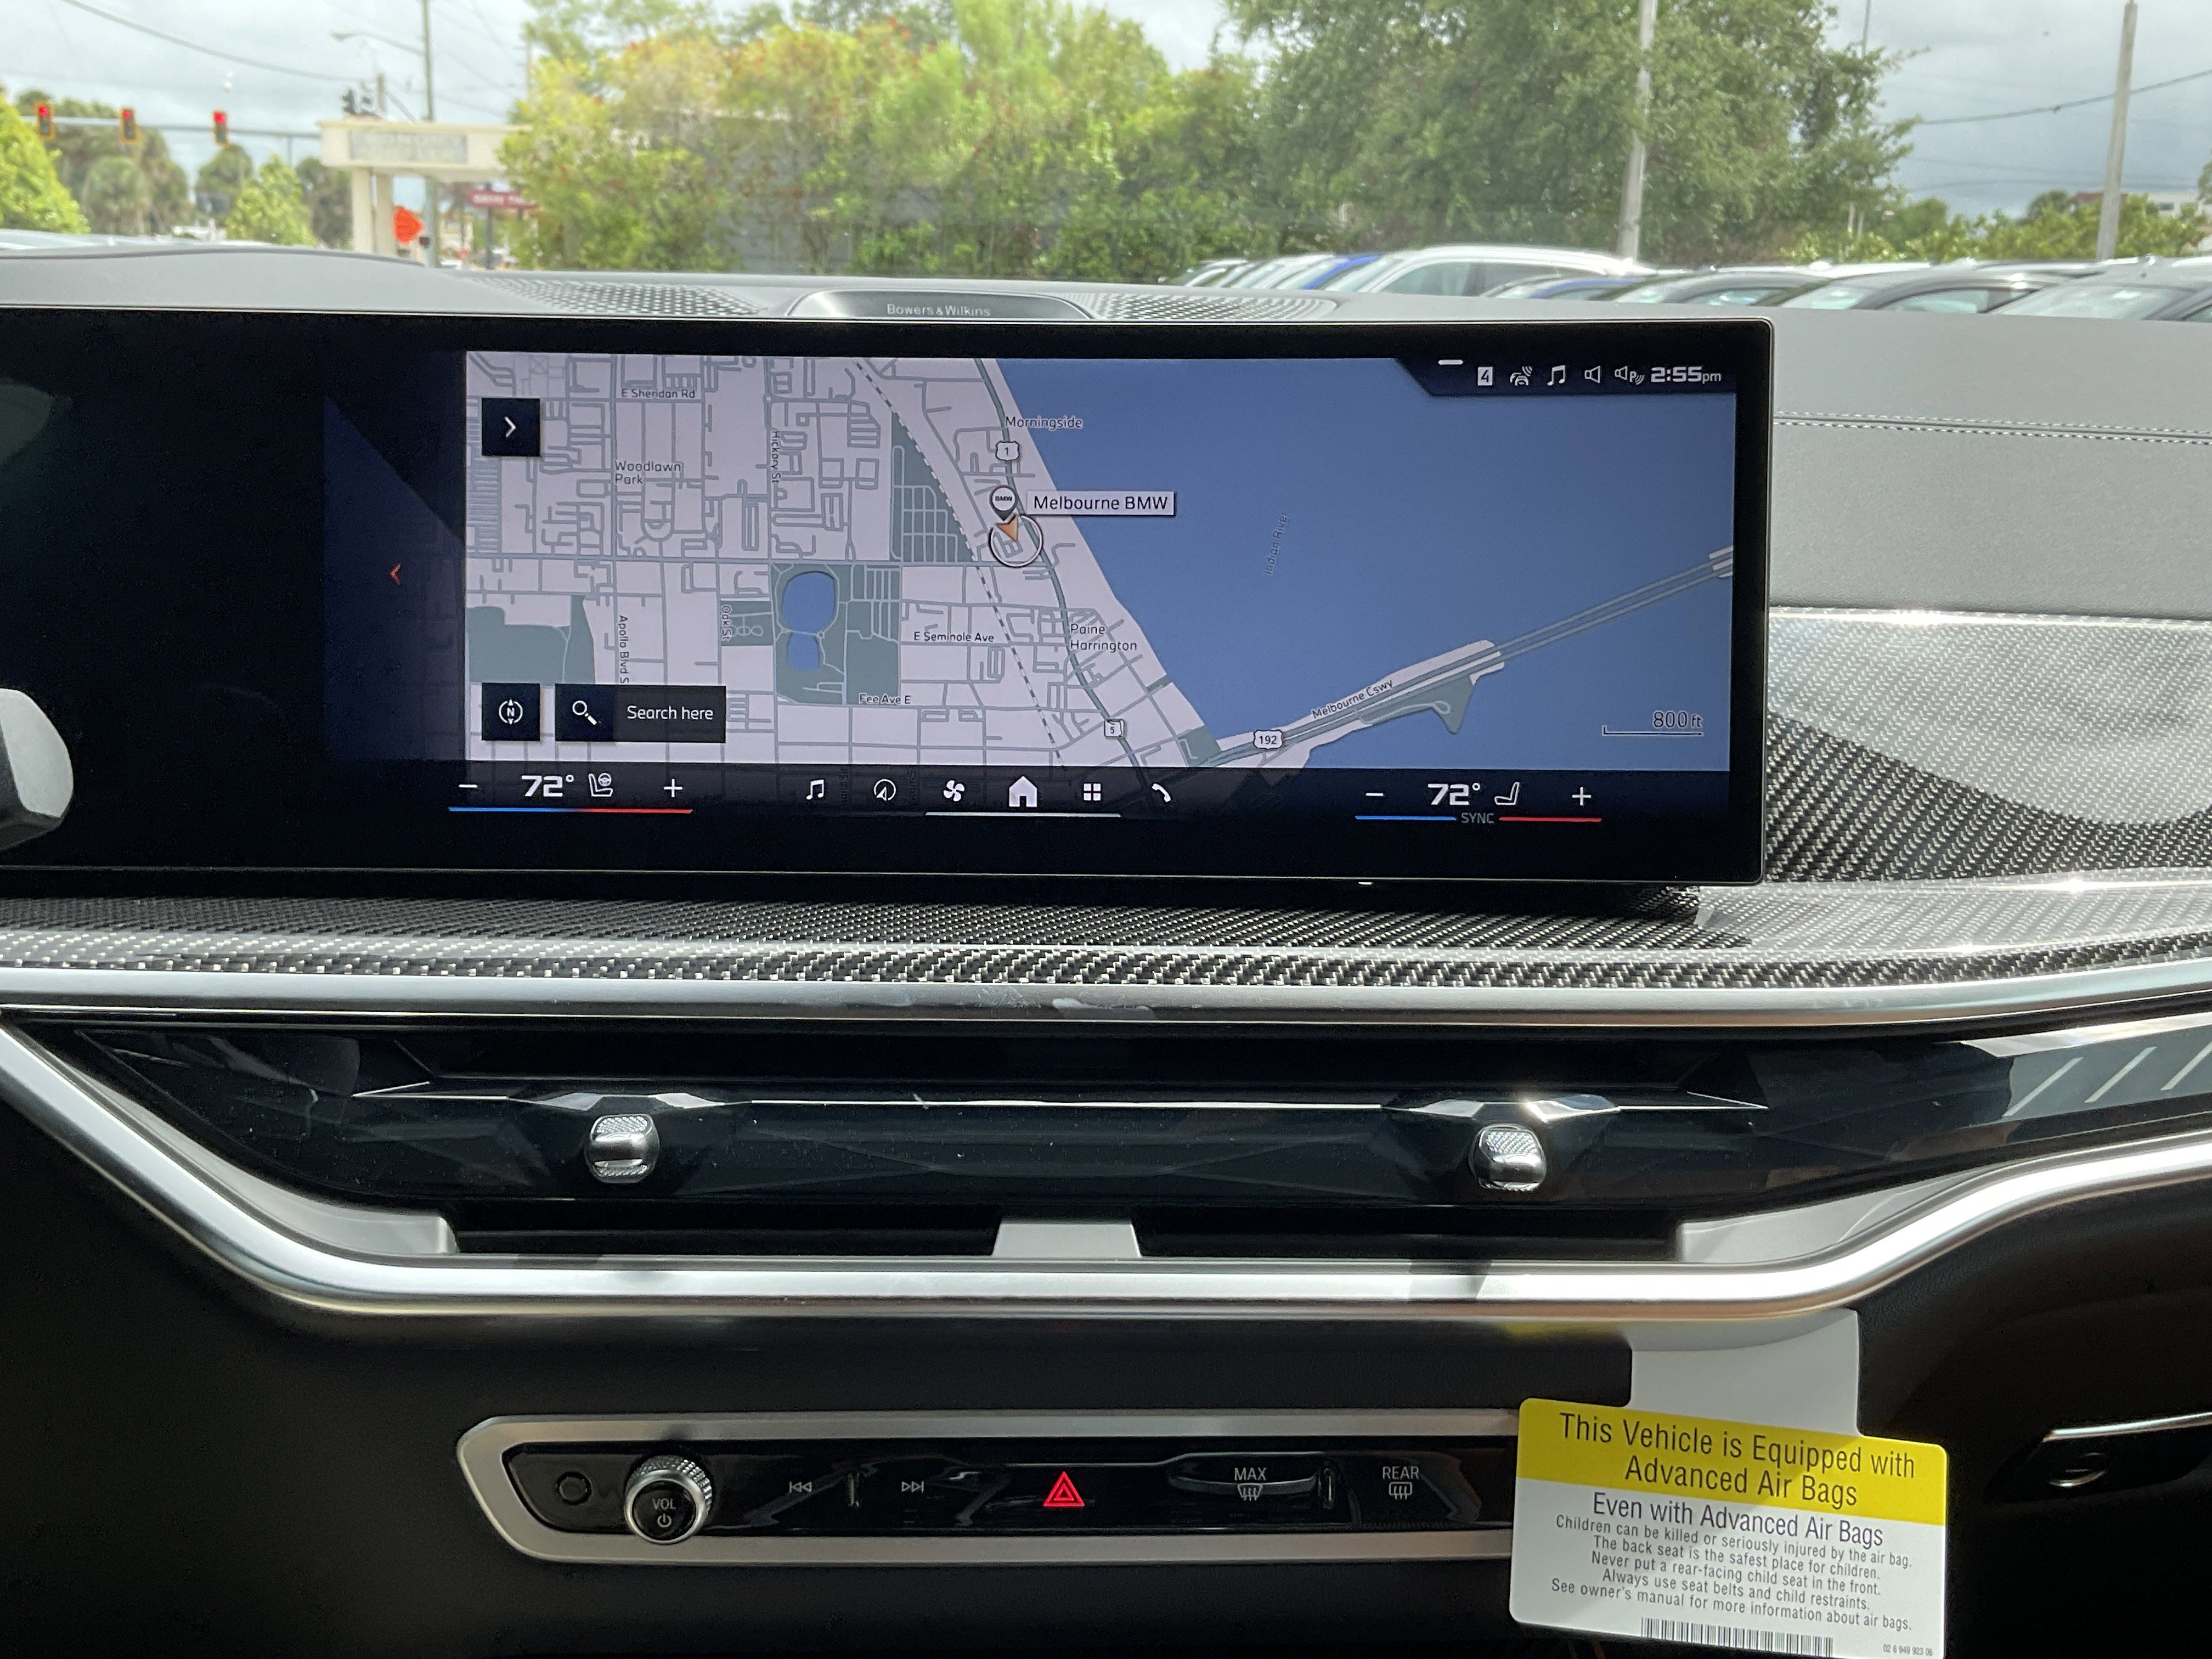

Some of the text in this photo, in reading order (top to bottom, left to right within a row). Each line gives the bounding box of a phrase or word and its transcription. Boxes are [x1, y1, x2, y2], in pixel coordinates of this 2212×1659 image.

[887, 303, 990, 317] Bowers & Wilkins
[1481, 368, 1490, 383] 4
[621, 388, 696, 399] E Sheridan Rd
[1005, 415, 1084, 431] Morningside
[770, 431, 781, 484] Hickory St
[1004, 447, 1009, 456] 1
[614, 460, 682, 472] Woodlawn
[614, 473, 644, 485] Park
[1034, 495, 1168, 510] Melbourne BMW
[1264, 511, 1289, 576] Indian River
[721, 605, 732, 641] Oak St
[1070, 623, 1106, 636] Paine
[618, 614, 629, 648] Apollo
[913, 631, 995, 644] E Seminole Ave
[1070, 640, 1138, 654] Harrington
[619, 651, 630, 674] Blvd
[881, 694, 901, 703] Ave
[904, 695, 911, 704] E
[1312, 680, 1393, 719] Melbourne Cswy
[506, 707, 515, 717] N
[627, 705, 714, 720] Search here
[1653, 711, 1702, 729] 800 ft
[1110, 726, 1115, 734] 5
[1259, 735, 1278, 745] 192
[521, 774, 574, 797] 72°
[1427, 782, 1481, 806] 72°
[1461, 812, 1495, 824] SYNC
[1559, 1412, 1915, 1479] This Vehicle is Equipped with
[1234, 1467, 1267, 1481] MAX
[1382, 1466, 1420, 1480] REAR
[1624, 1454, 1858, 1510] Advanced Air Bags
[652, 1498, 677, 1510] VOL
[1593, 1491, 1883, 1549] Even with Advanced Air Bags
[1556, 1514, 1912, 1570] Children can be killed or seriously injured by the air bag.
[1593, 1534, 1881, 1580] The back seat is the safest place for children.
[1592, 1551, 1881, 1596] Never put a rear-facing child seat in the front.
[1601, 1568, 1871, 1611] Always use seat belts and child restraints.
[1551, 1577, 1912, 1632] See owner's manual for more information about air bags.
[1882, 1644, 1892, 1653] 02
